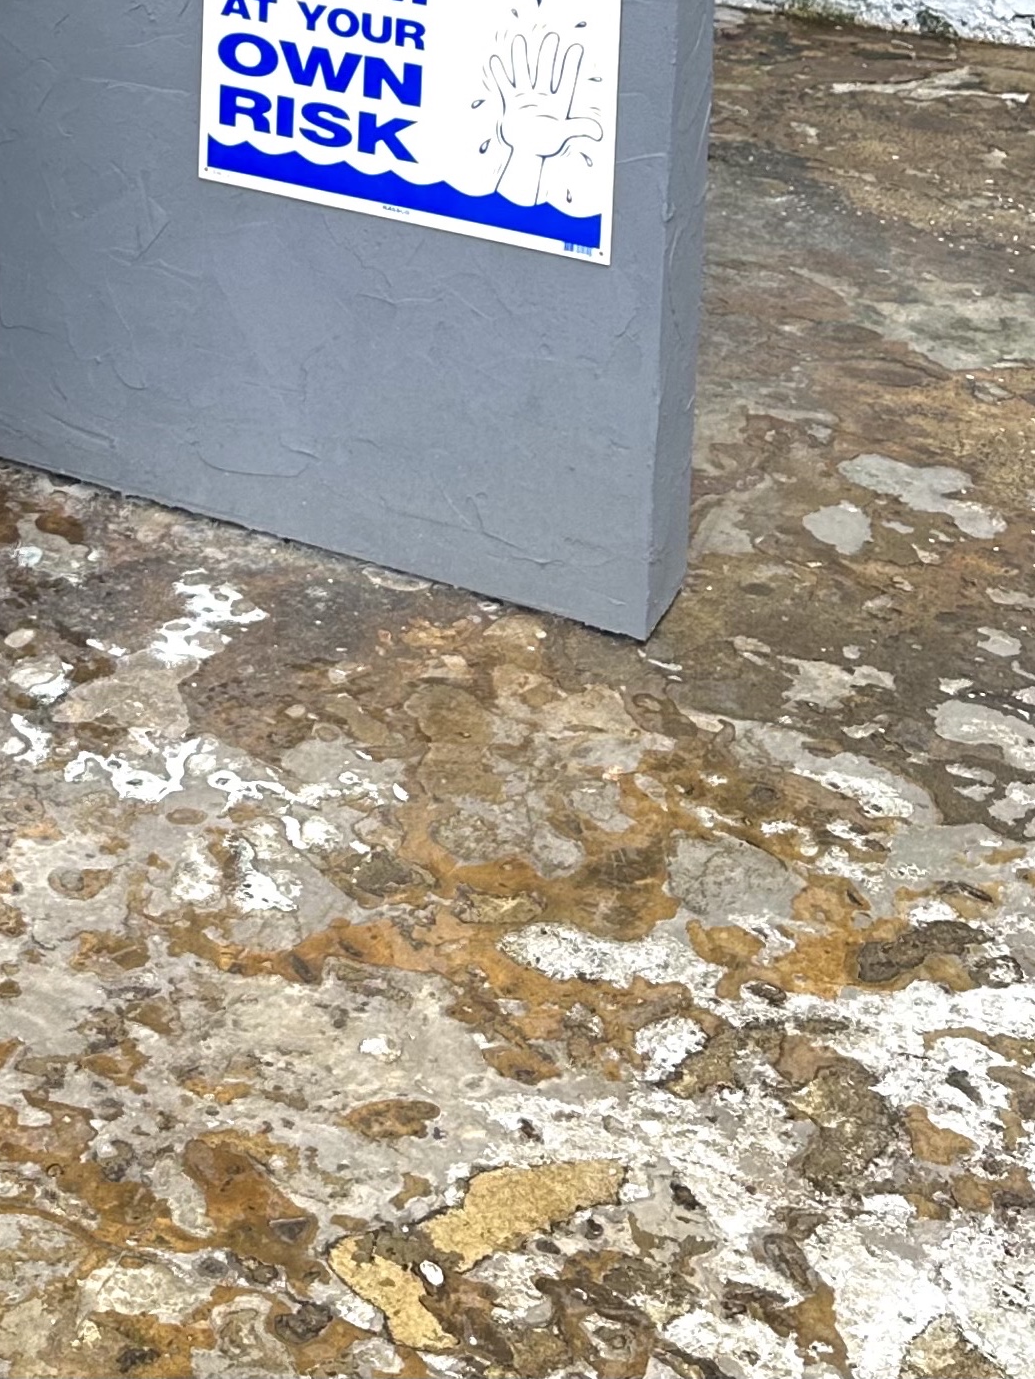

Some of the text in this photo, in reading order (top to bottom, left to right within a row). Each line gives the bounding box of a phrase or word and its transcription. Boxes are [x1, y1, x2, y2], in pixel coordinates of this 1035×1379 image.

[296, 0, 426, 50] YOUR
[217, 32, 423, 108] OWN
[218, 84, 418, 164] RISK
